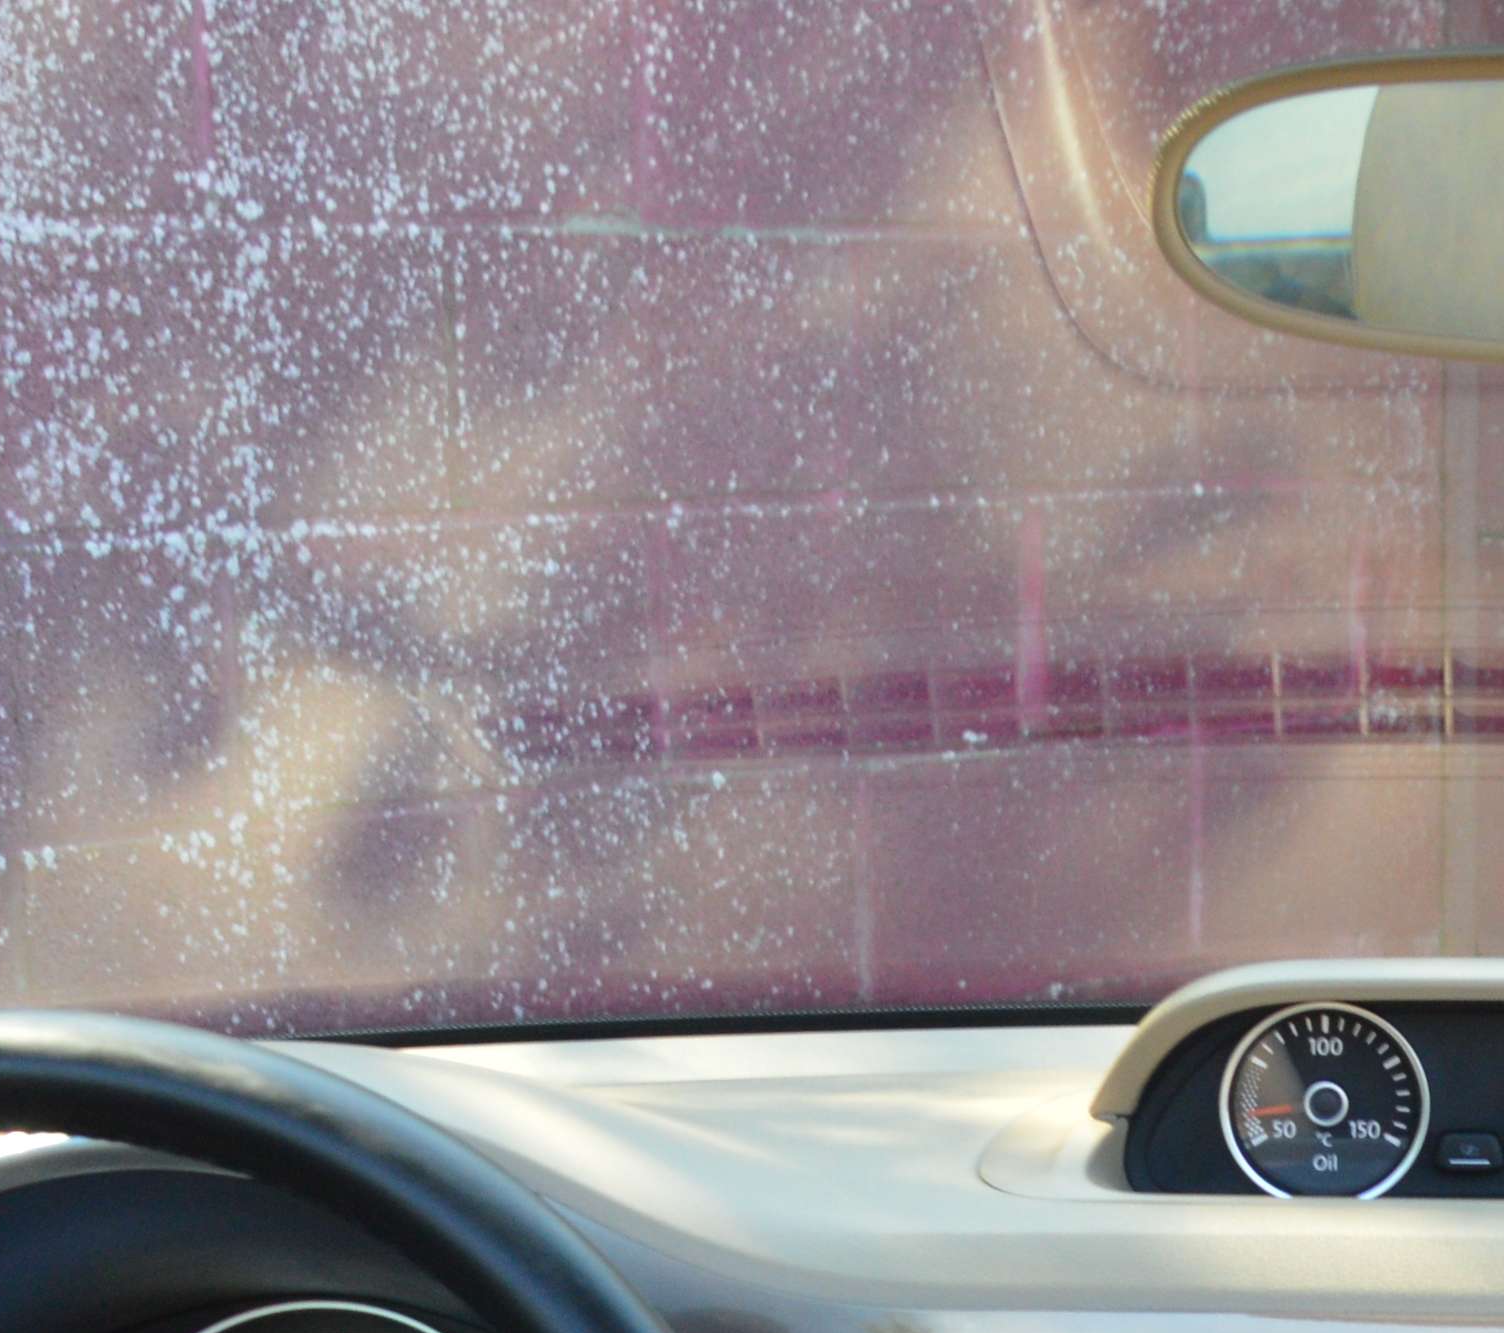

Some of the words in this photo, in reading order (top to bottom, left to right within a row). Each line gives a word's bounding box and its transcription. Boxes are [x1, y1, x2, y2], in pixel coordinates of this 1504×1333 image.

[1308, 1036, 1344, 1056] 100
[1273, 1120, 1296, 1139] 50
[1349, 1120, 1381, 1139] 150
[1312, 1155, 1338, 1172] Oil
